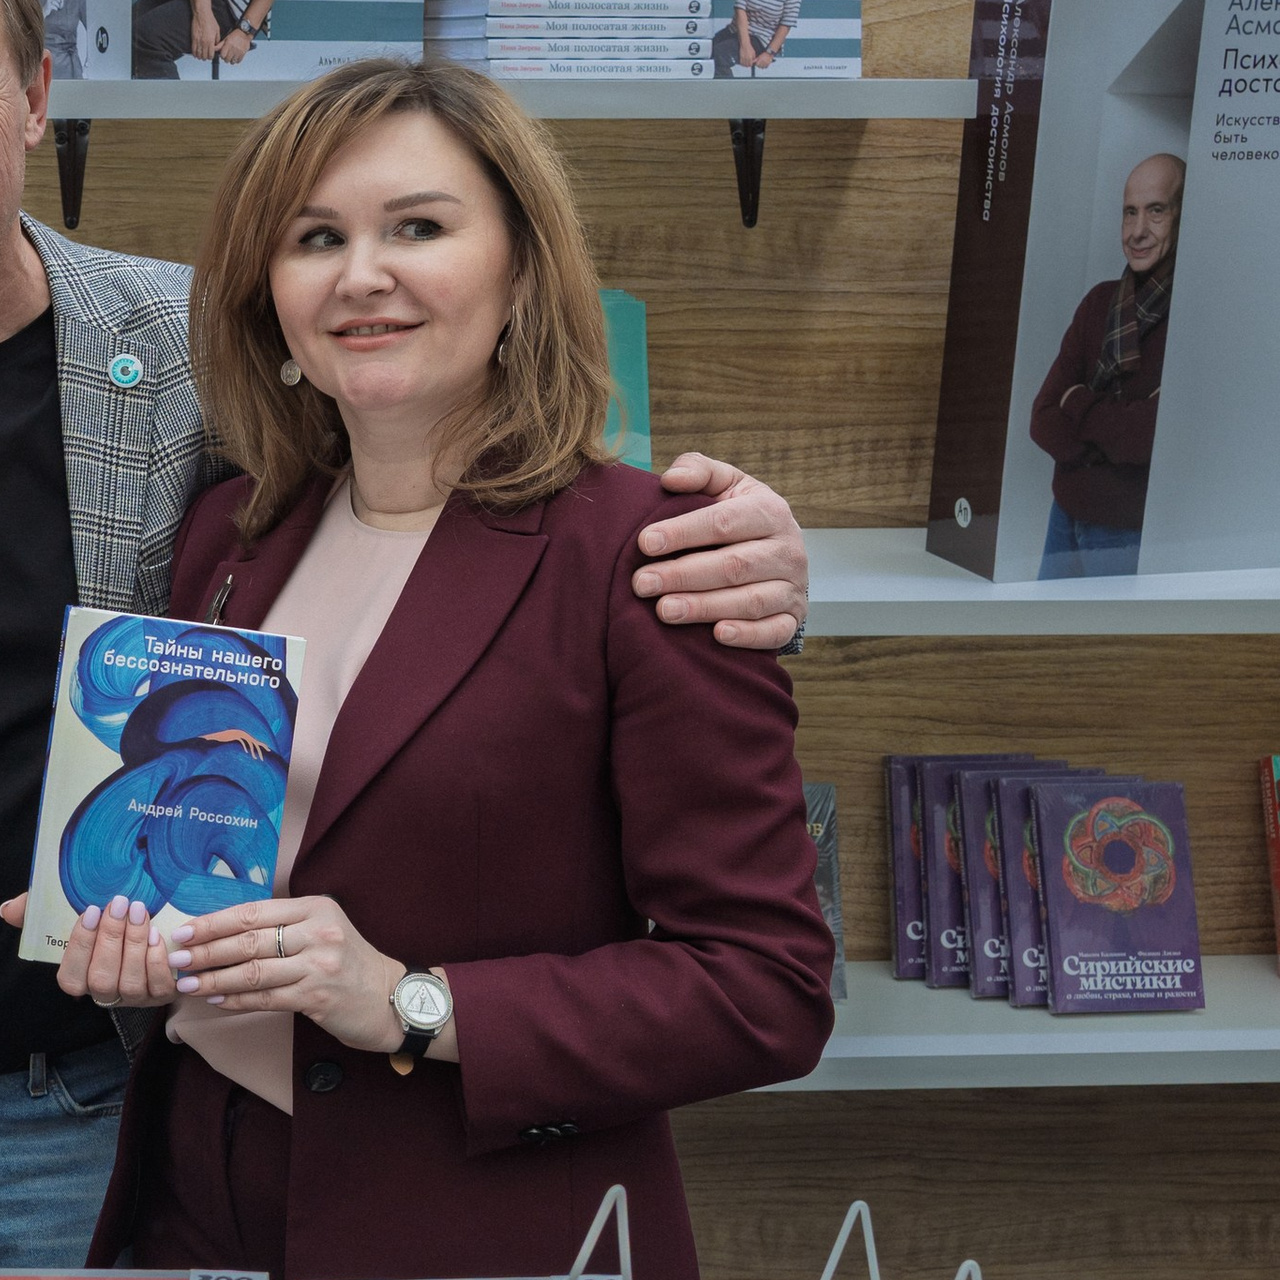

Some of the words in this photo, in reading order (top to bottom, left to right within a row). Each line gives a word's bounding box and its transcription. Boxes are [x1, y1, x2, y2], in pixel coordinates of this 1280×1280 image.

[998, 101, 1016, 182] Асмолов
[1213, 130, 1249, 144] быть
[982, 103, 1000, 222] достоинства
[103, 649, 281, 689] бессознательного
[144, 635, 203, 661] Тайны
[211, 648, 283, 672] нашего
[127, 798, 183, 819] Андрей
[189, 807, 259, 830] Россохин
[1062, 955, 1196, 977] Сирийские
[1077, 973, 1183, 992] мистики
